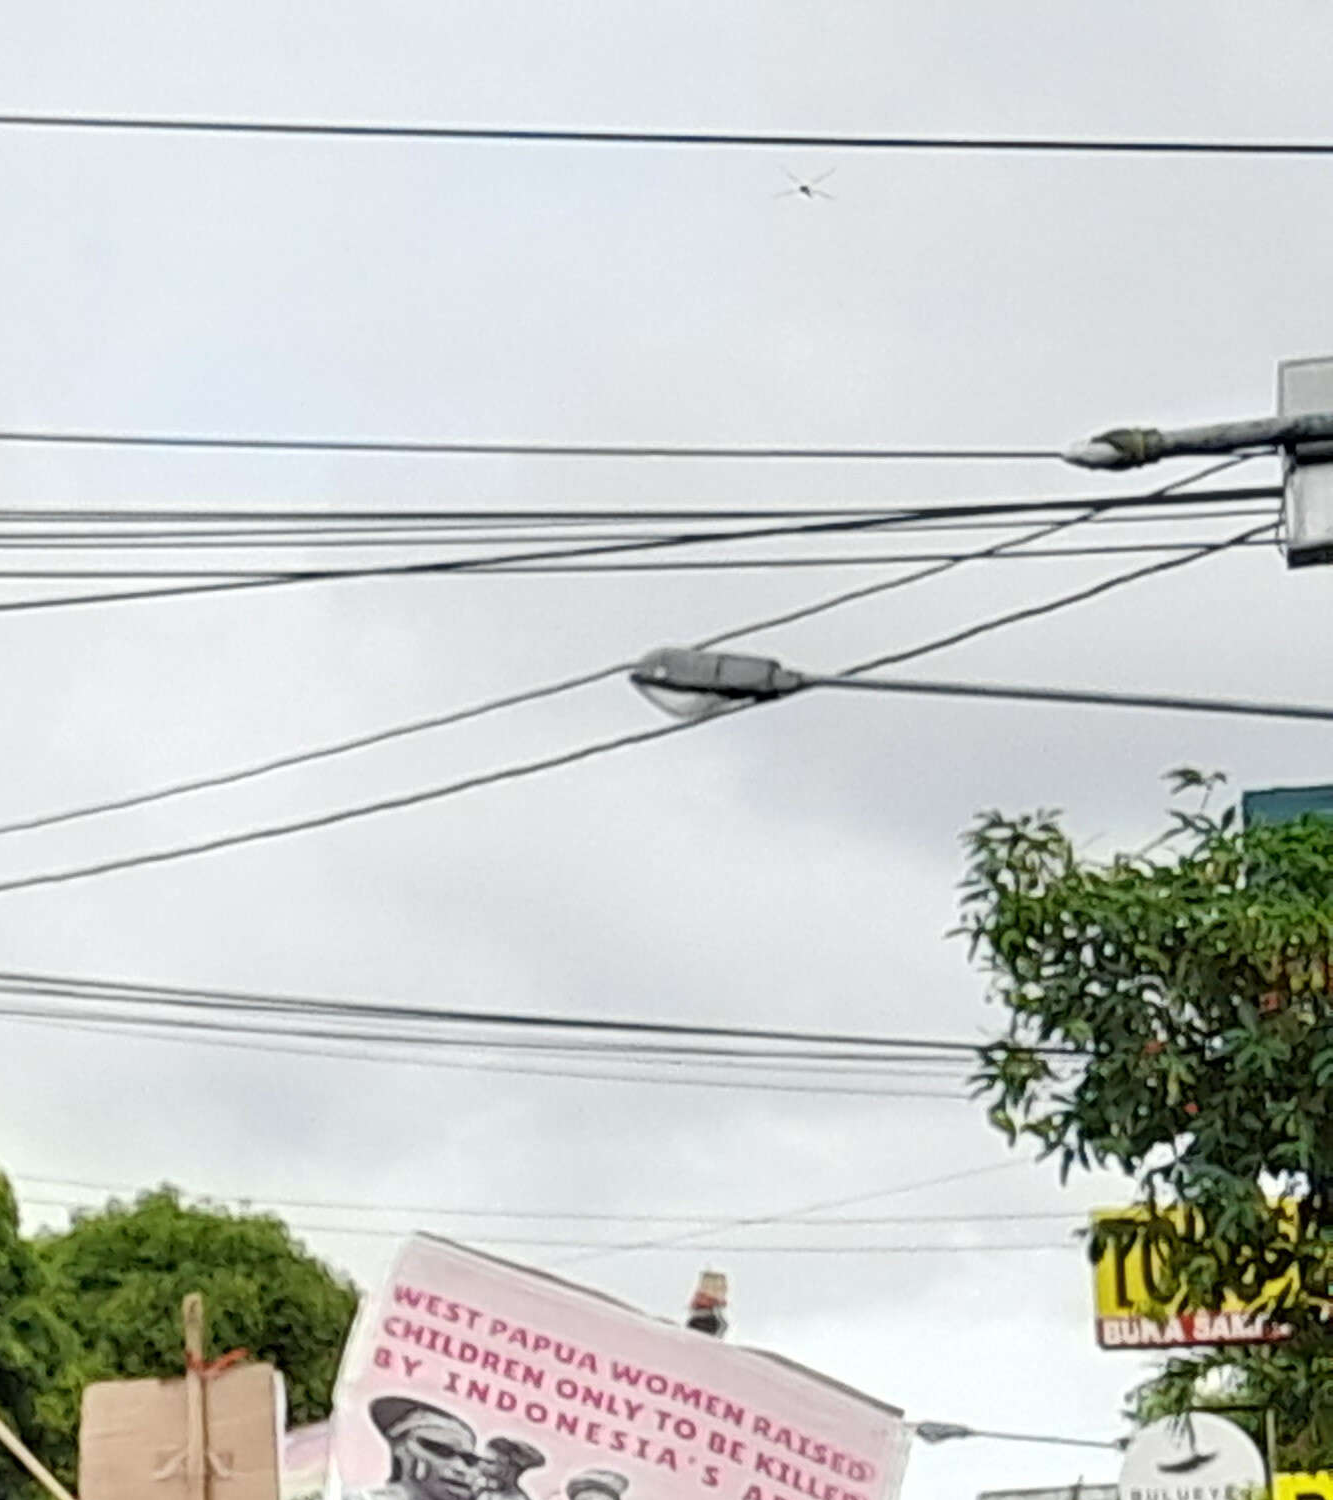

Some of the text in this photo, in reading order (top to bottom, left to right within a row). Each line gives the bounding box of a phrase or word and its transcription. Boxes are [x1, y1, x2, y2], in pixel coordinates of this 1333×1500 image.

[372, 1346, 424, 1378] BY
[443, 1371, 721, 1489] INDONESIA'S
[382, 1316, 546, 1393] CHILDREN
[554, 1376, 643, 1425] ONLY
[654, 1409, 700, 1441] TO
[707, 1431, 749, 1465] BE
[392, 1283, 875, 1483] WEST PAPUA WOMEN RAISED
